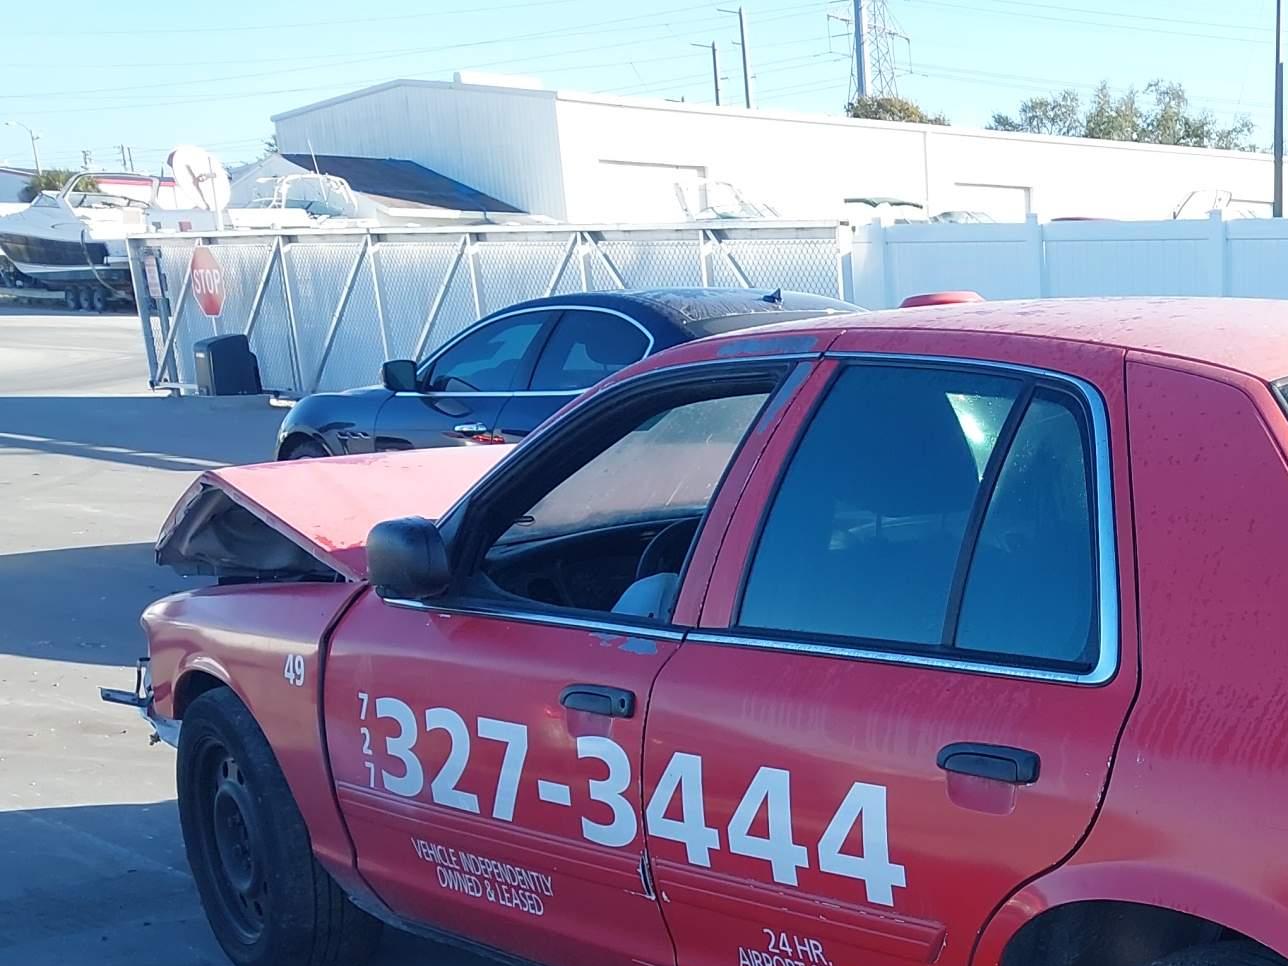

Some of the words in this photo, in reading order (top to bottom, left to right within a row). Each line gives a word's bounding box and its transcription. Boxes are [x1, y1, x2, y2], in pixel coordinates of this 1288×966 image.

[193, 268, 221, 294] STOP
[283, 653, 305, 687] 49
[375, 697, 906, 907] 327-3444
[410, 836, 460, 870] VEHICLE
[458, 851, 554, 897] INDEPENDENTLY
[436, 866, 483, 898] OWNED
[484, 879, 496, 902] &
[495, 882, 545, 916] LEASED
[762, 928, 793, 957] 24
[793, 935, 833, 966] HR.
